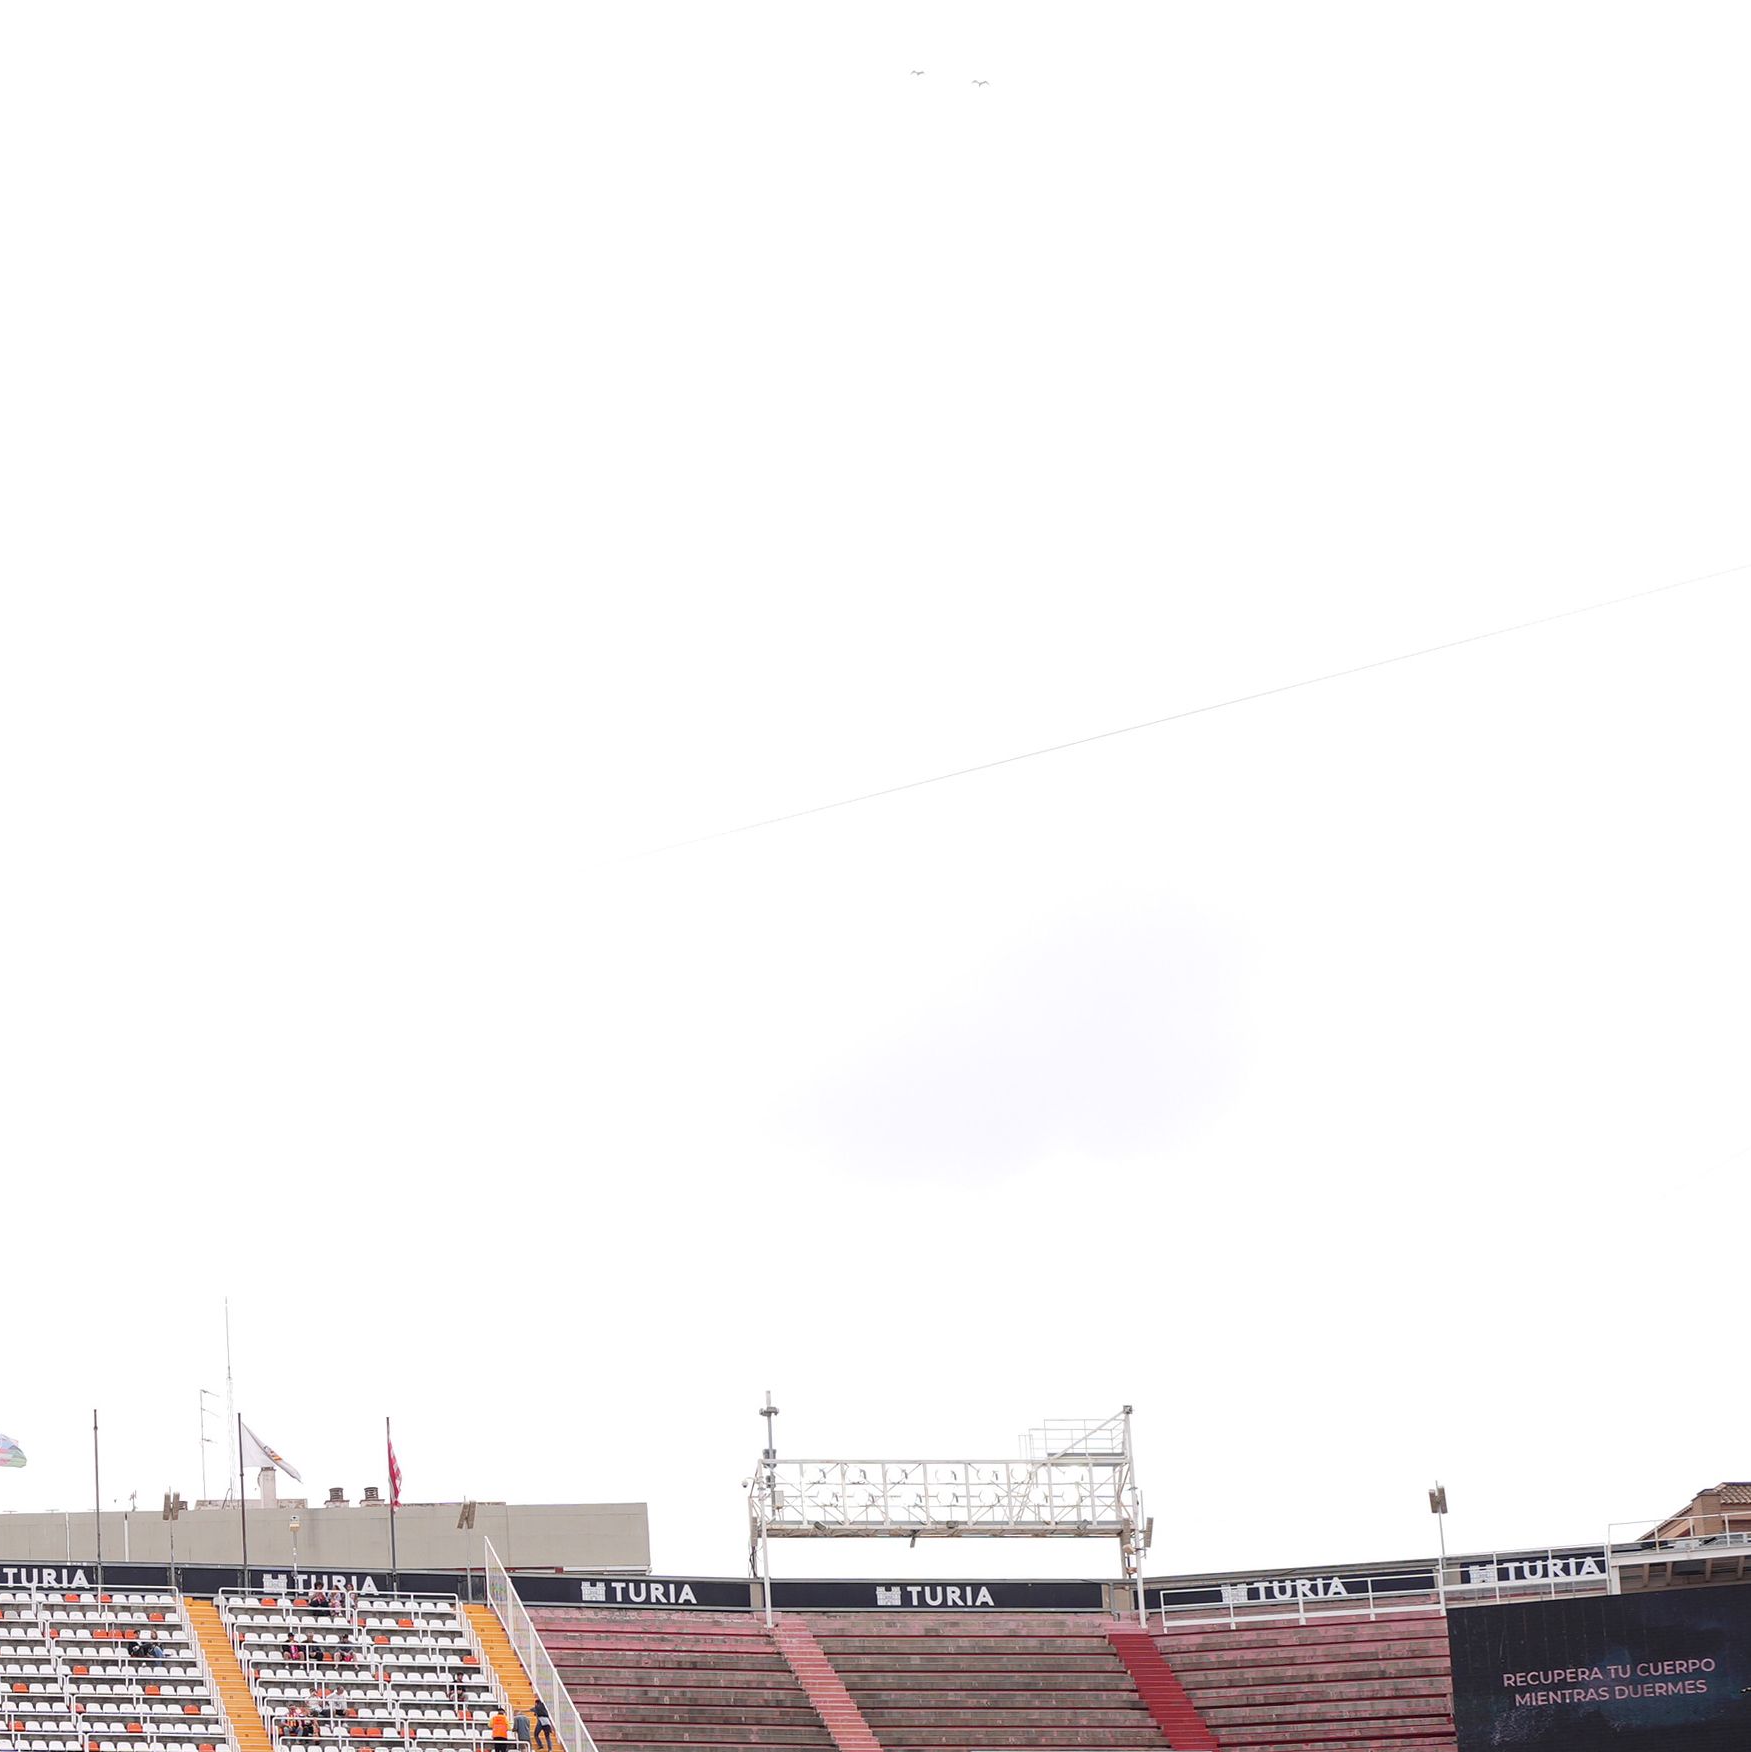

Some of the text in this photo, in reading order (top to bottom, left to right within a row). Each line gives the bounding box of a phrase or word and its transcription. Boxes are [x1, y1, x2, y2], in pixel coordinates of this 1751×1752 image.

[2, 1567, 90, 1590] TURIA
[1504, 1555, 1602, 1582] TURIA
[296, 1573, 379, 1596] TURIA
[610, 1581, 698, 1605] TURIA
[906, 1586, 995, 1607] TURIA
[1258, 1576, 1349, 1601] TURIA
[1503, 1657, 1716, 1688] RECUPERA TU CUERPO
[1514, 1679, 1708, 1707] MIENTRAS DUERMES
